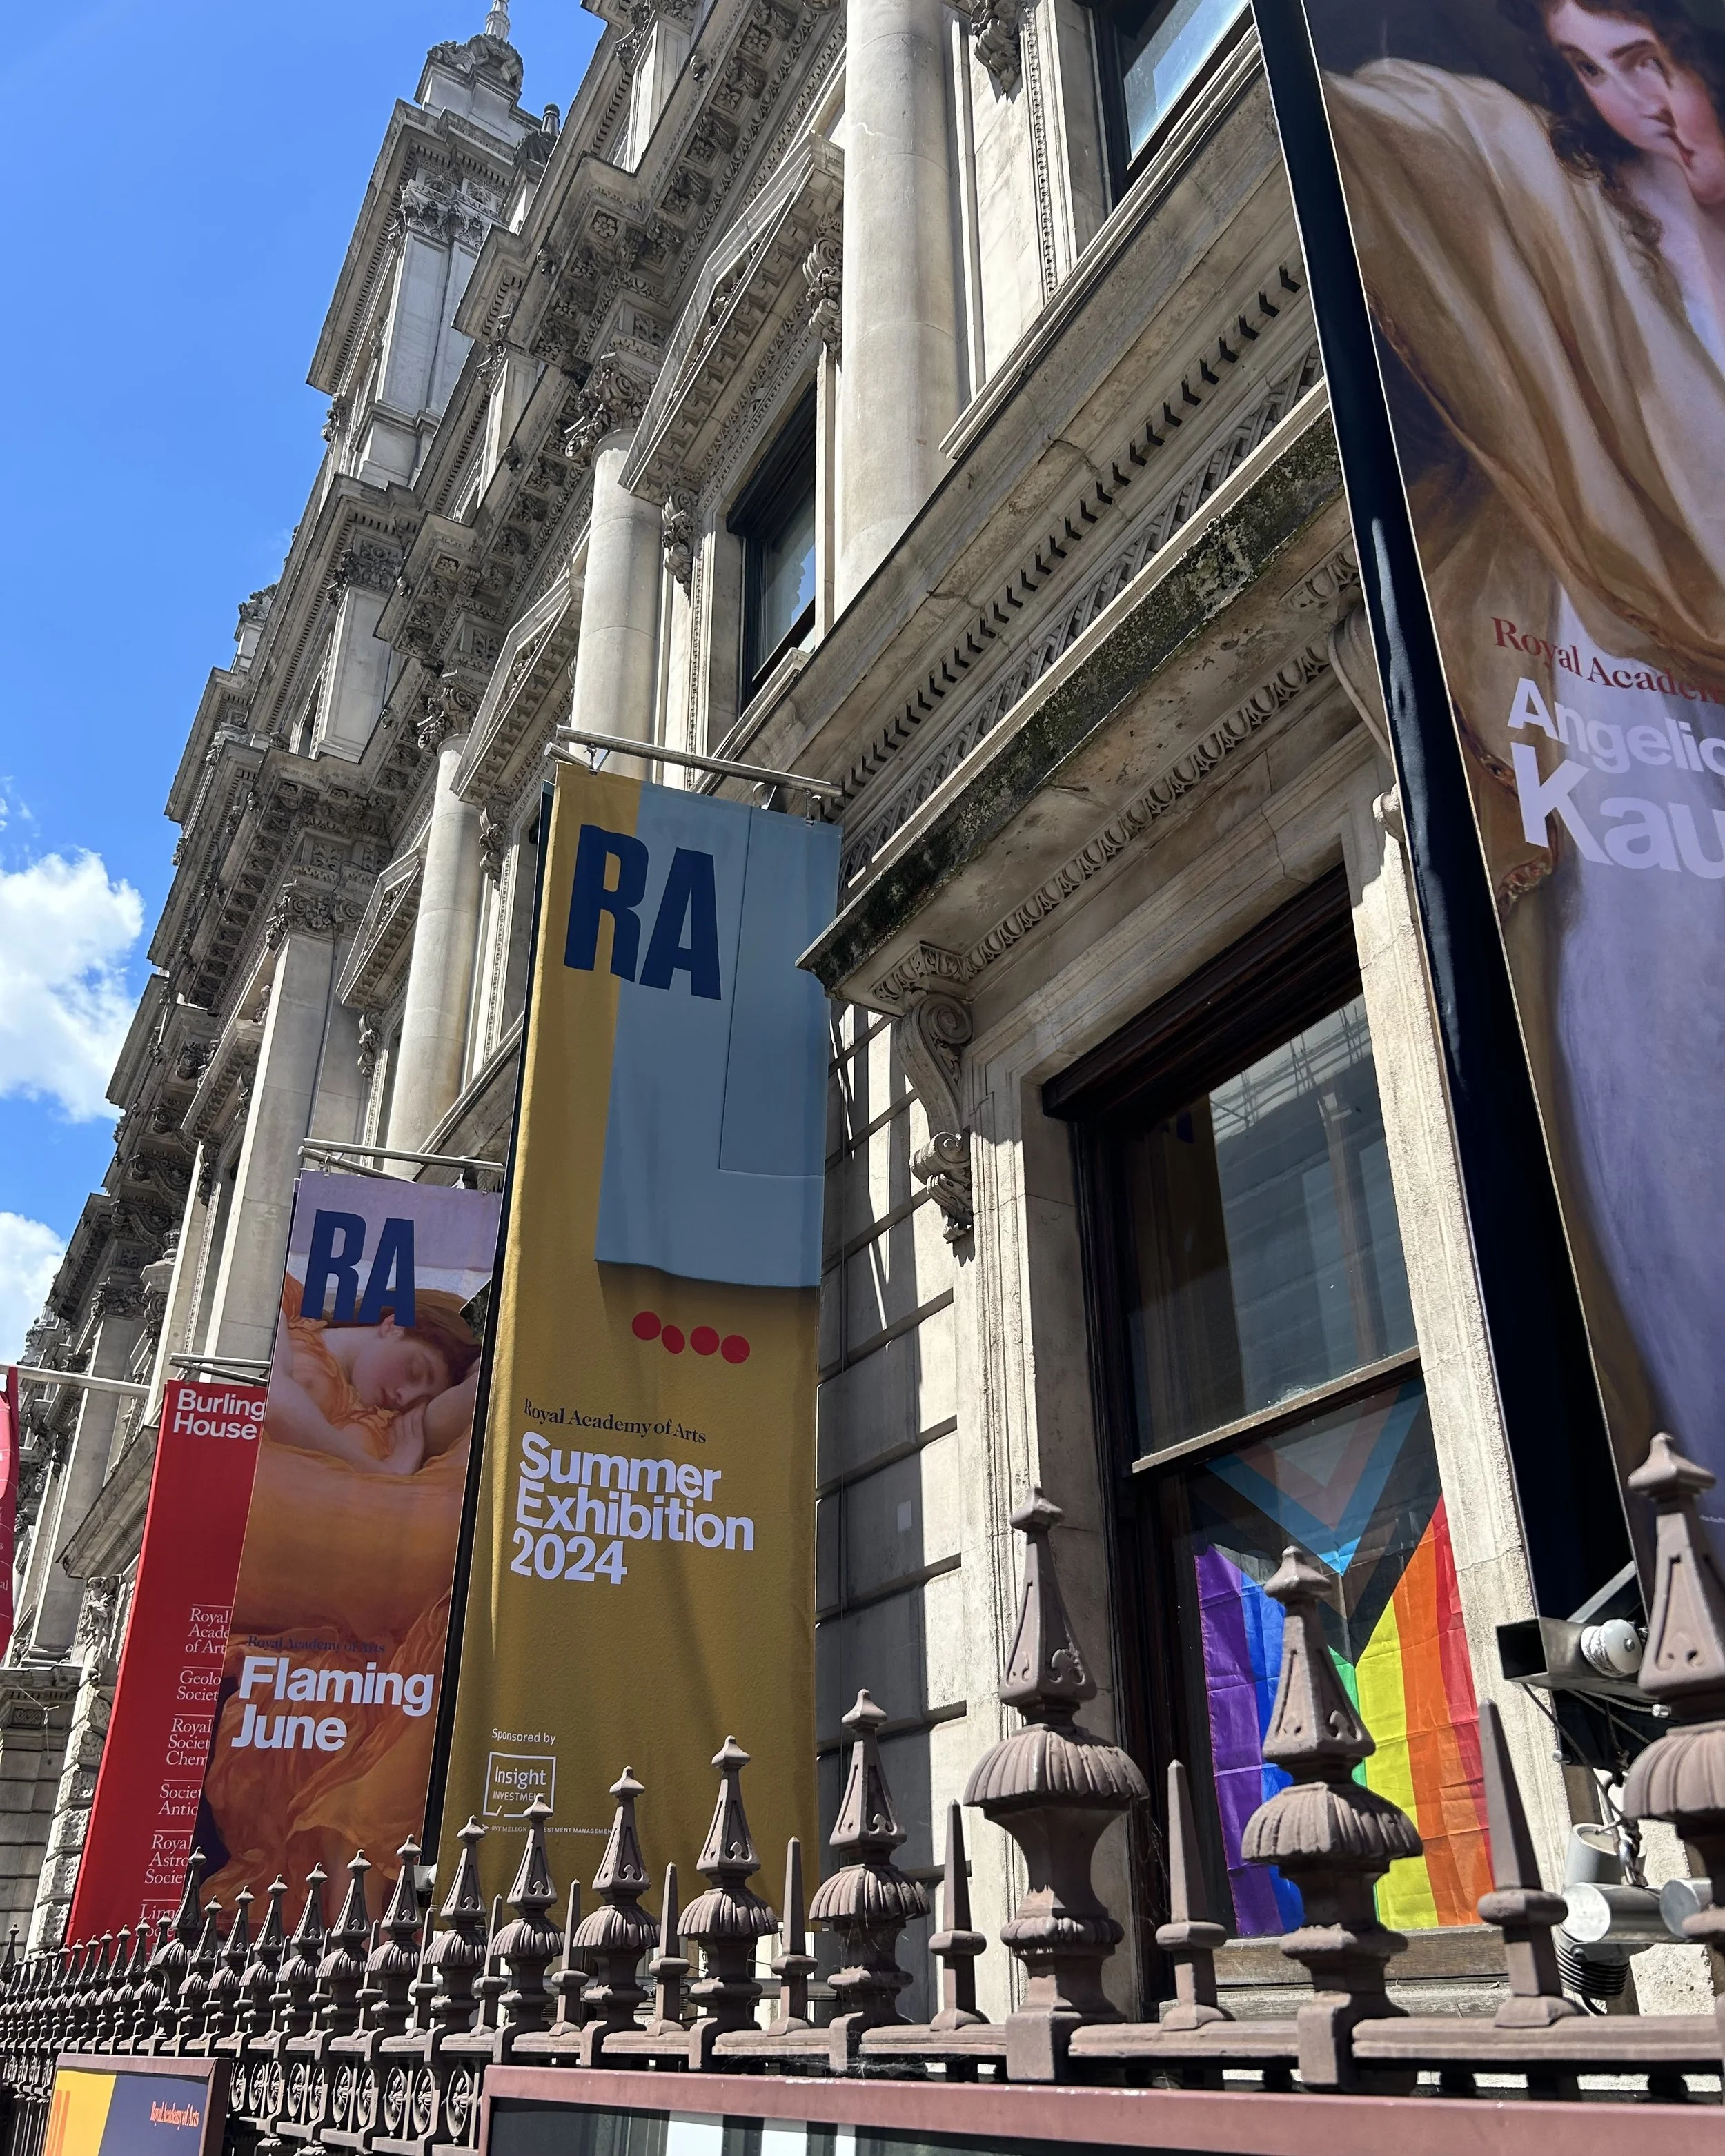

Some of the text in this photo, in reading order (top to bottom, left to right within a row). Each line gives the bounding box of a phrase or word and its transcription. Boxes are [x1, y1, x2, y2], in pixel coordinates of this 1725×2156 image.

[1490, 617, 1583, 678] Royal
[1510, 741, 1725, 880] Kau
[564, 824, 722, 1000] RA
[300, 1209, 416, 1327] RA
[177, 1388, 266, 1421] Burling
[524, 1398, 707, 1444] Royal Academy of Arts
[173, 1412, 257, 1440] House
[519, 1431, 722, 1502] Summer
[516, 1475, 755, 1552] Exhibition
[511, 1527, 628, 1585] 2024
[190, 1608, 229, 1626] Royal
[185, 1639, 202, 1653] of
[248, 1635, 282, 1650] Royal
[288, 1637, 340, 1654] Academy
[344, 1639, 357, 1652] of
[179, 1670, 221, 1685] Geolo
[239, 1655, 435, 1717] Flaming
[171, 1717, 213, 1737] Royal
[231, 1704, 347, 1752] June
[491, 1728, 556, 1745] Sponsored by
[495, 1766, 546, 1790] Insight
[151, 1834, 193, 1854] Royal
